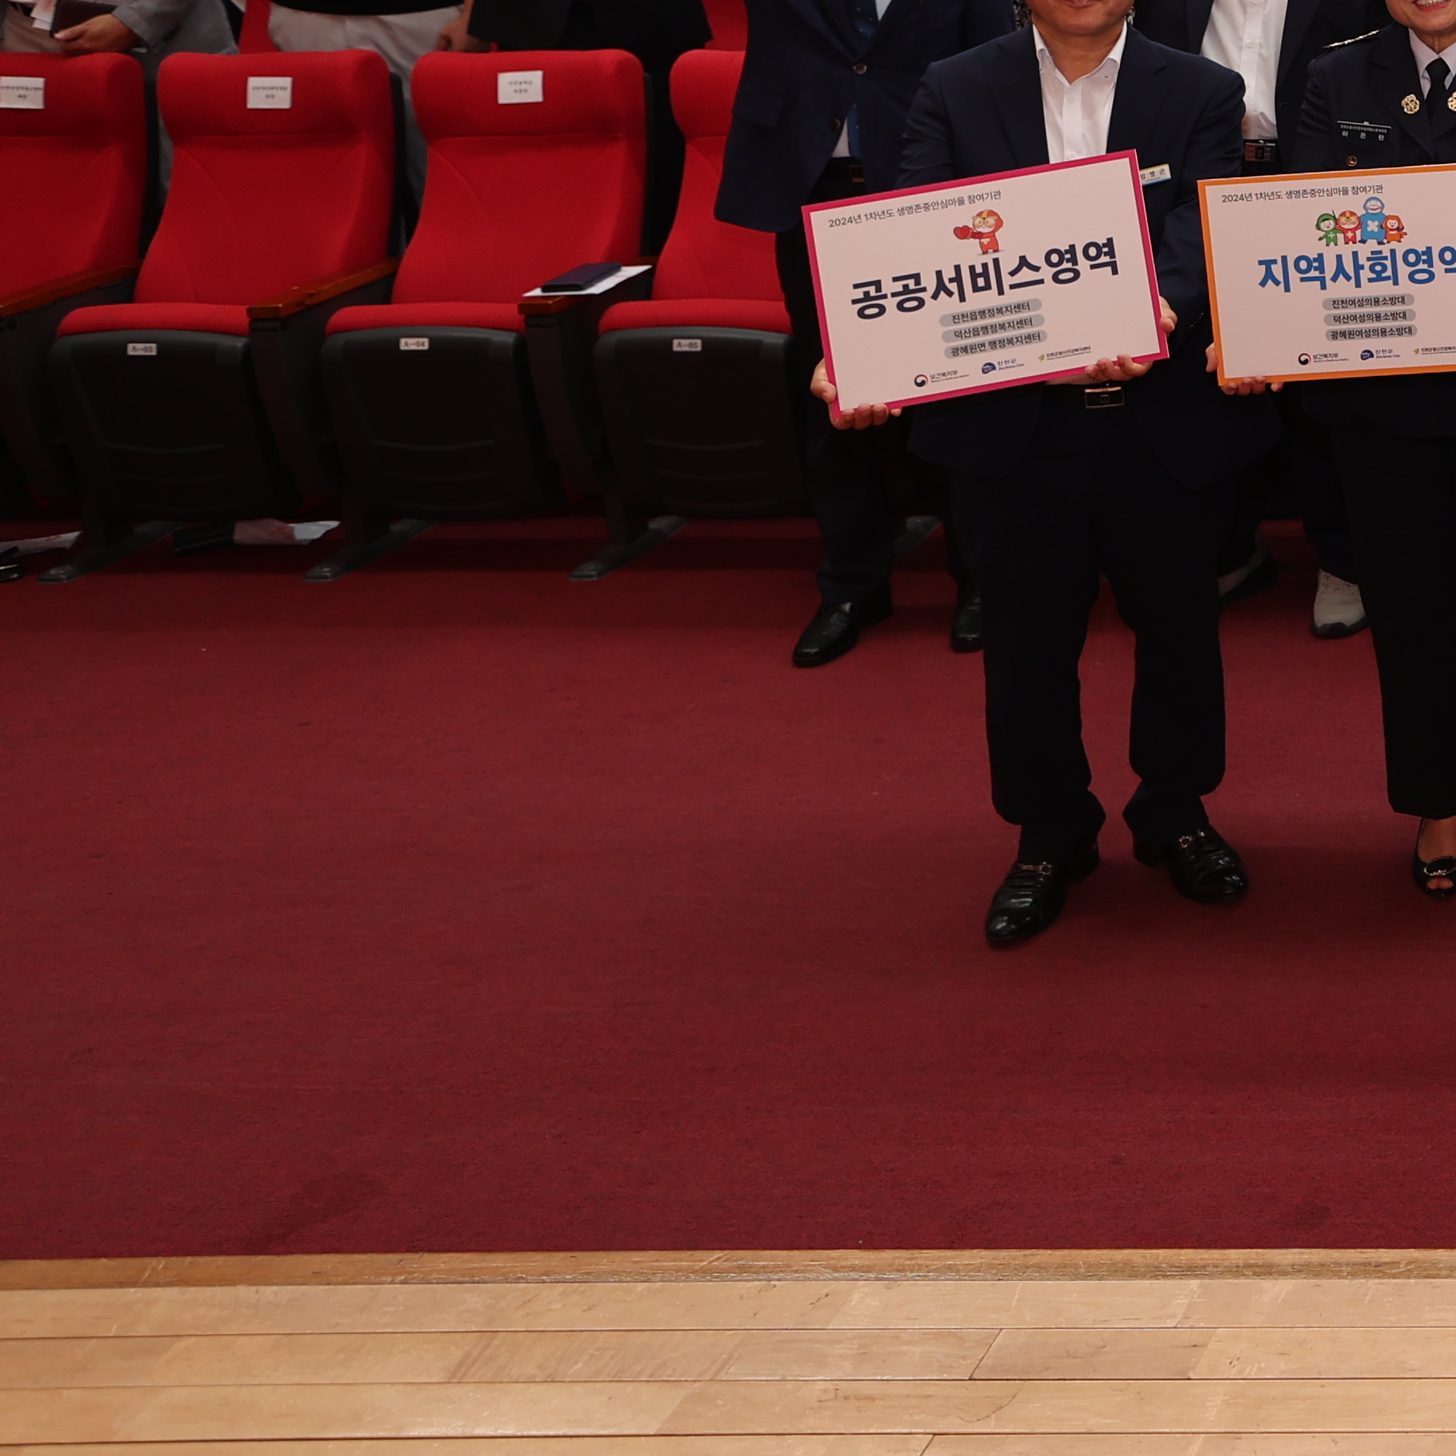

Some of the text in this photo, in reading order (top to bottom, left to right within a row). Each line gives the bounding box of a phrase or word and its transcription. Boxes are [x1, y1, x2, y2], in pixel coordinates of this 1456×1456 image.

[1222, 184, 1384, 204] 2024년 1차년도 생명존중안심마을 참여기관
[828, 190, 1002, 228] 2024년 1차년도 생명존중안심마을 참여기관
[850, 236, 1120, 320] 공공서비스영역
[951, 302, 1031, 325] 진천읍행정복지센터
[1331, 296, 1406, 310] 진천여성의용소방대
[953, 317, 1034, 340] 덕산읍행정복지센터
[1333, 310, 1407, 325] 덕산여성의용소방대
[950, 331, 1042, 356] 광혜원면 행정복지센터
[1330, 326, 1413, 341] 광혜원여성의용소방대
